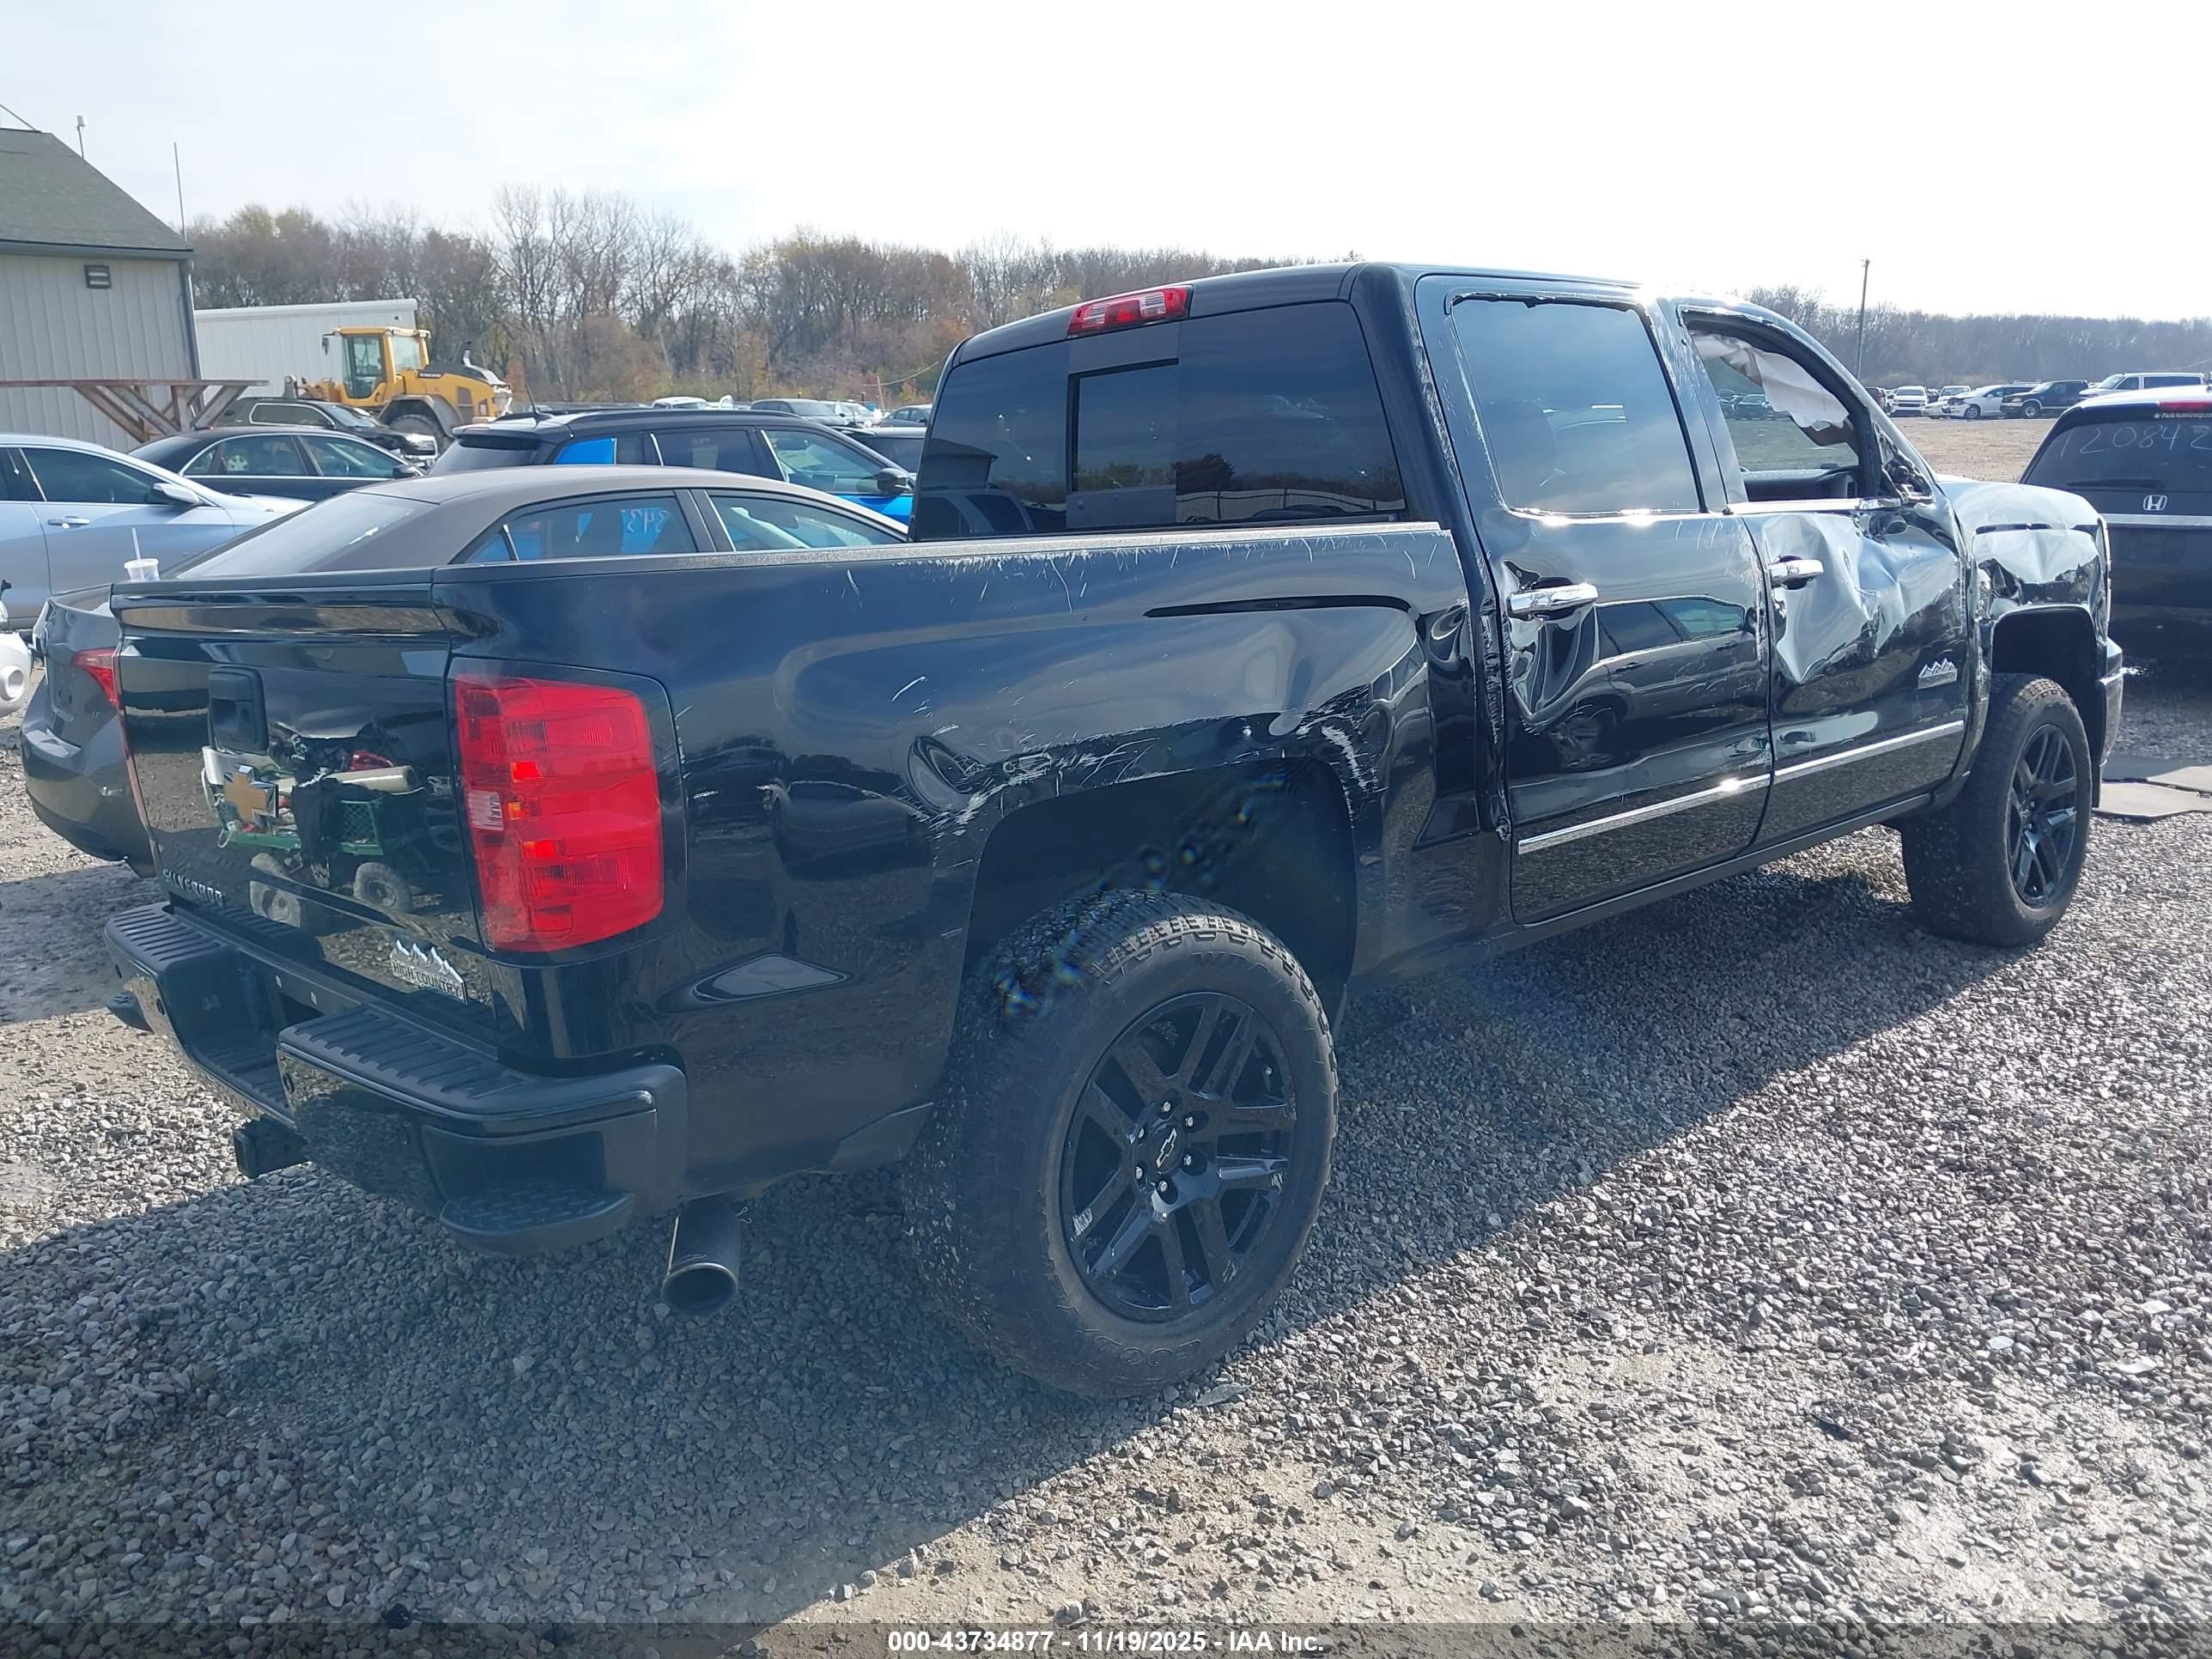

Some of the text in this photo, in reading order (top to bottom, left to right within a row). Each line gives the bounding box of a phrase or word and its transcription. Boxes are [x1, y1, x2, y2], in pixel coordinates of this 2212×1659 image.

[162, 868, 223, 907] SILVERADO
[392, 962, 459, 996] HIGH COUNTRY
